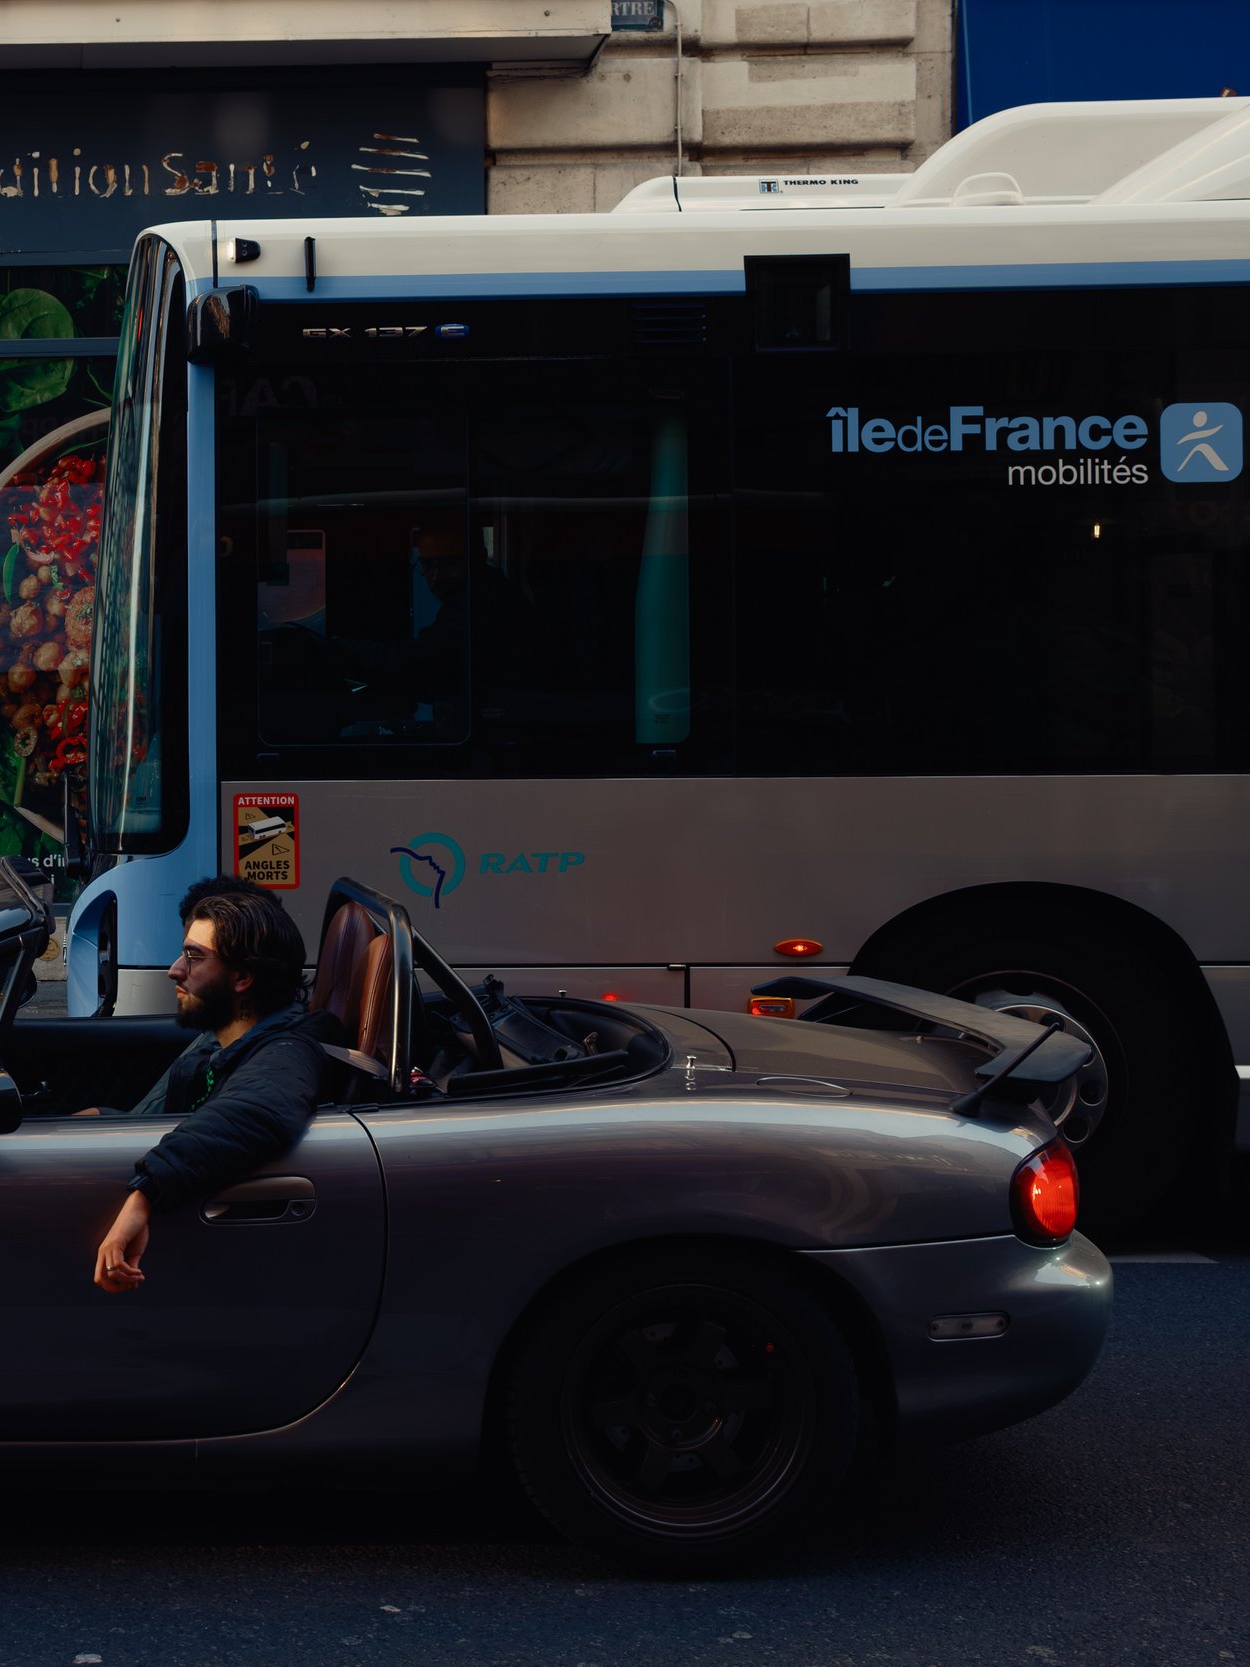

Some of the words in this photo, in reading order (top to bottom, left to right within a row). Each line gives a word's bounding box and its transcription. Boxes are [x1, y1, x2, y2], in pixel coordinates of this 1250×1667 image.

[302, 327, 351, 338] GX
[364, 326, 428, 337] 137
[1007, 455, 1149, 486] mobilités
[238, 796, 295, 806] ATTENTION
[244, 860, 291, 871] ANGLES
[478, 851, 586, 875] RATP
[247, 870, 289, 881] MORTS
